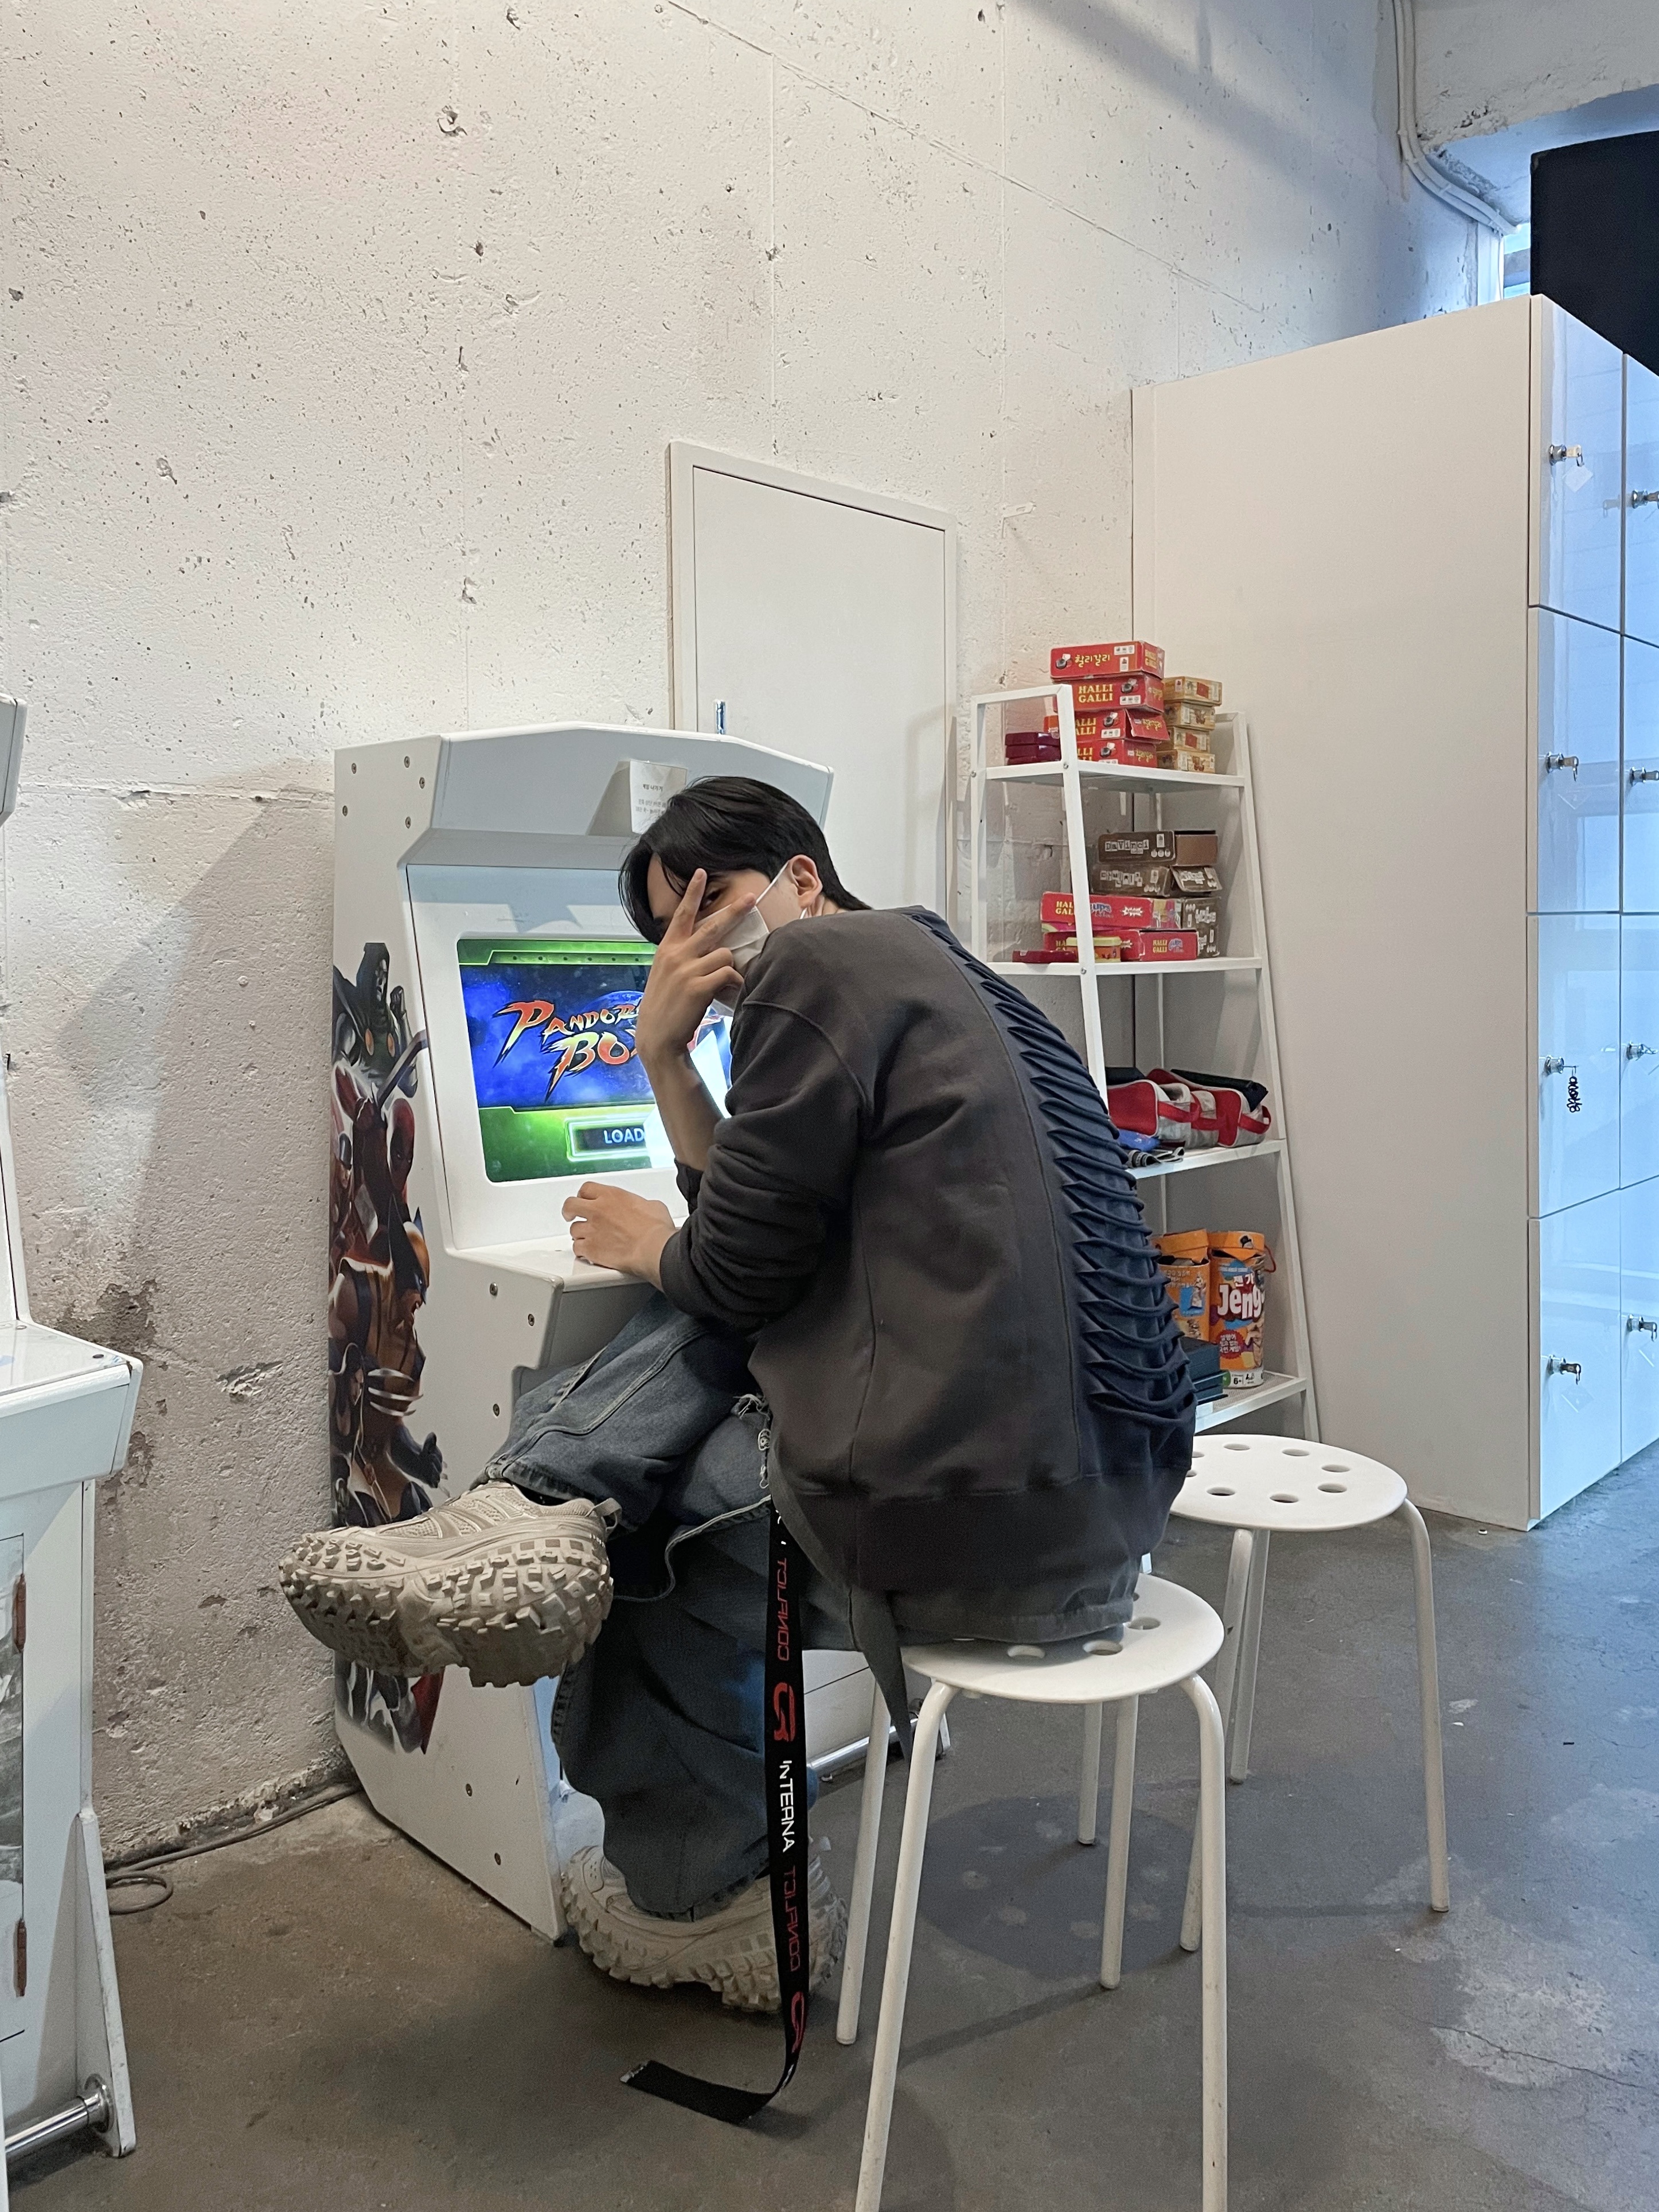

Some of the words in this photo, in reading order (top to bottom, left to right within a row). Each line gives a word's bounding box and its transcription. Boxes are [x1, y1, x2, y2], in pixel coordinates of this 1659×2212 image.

[1075, 653, 1110, 668] 할리갈리
[1079, 684, 1113, 694] HALLI
[1078, 693, 1113, 703] GALLI
[1075, 717, 1096, 727] ALLI
[1075, 727, 1096, 736] ALLI
[1078, 747, 1093, 756] LLI
[493, 1000, 639, 1064] PANDOR
[545, 1031, 638, 1098] BO
[1217, 1284, 1264, 1320] Jeng
